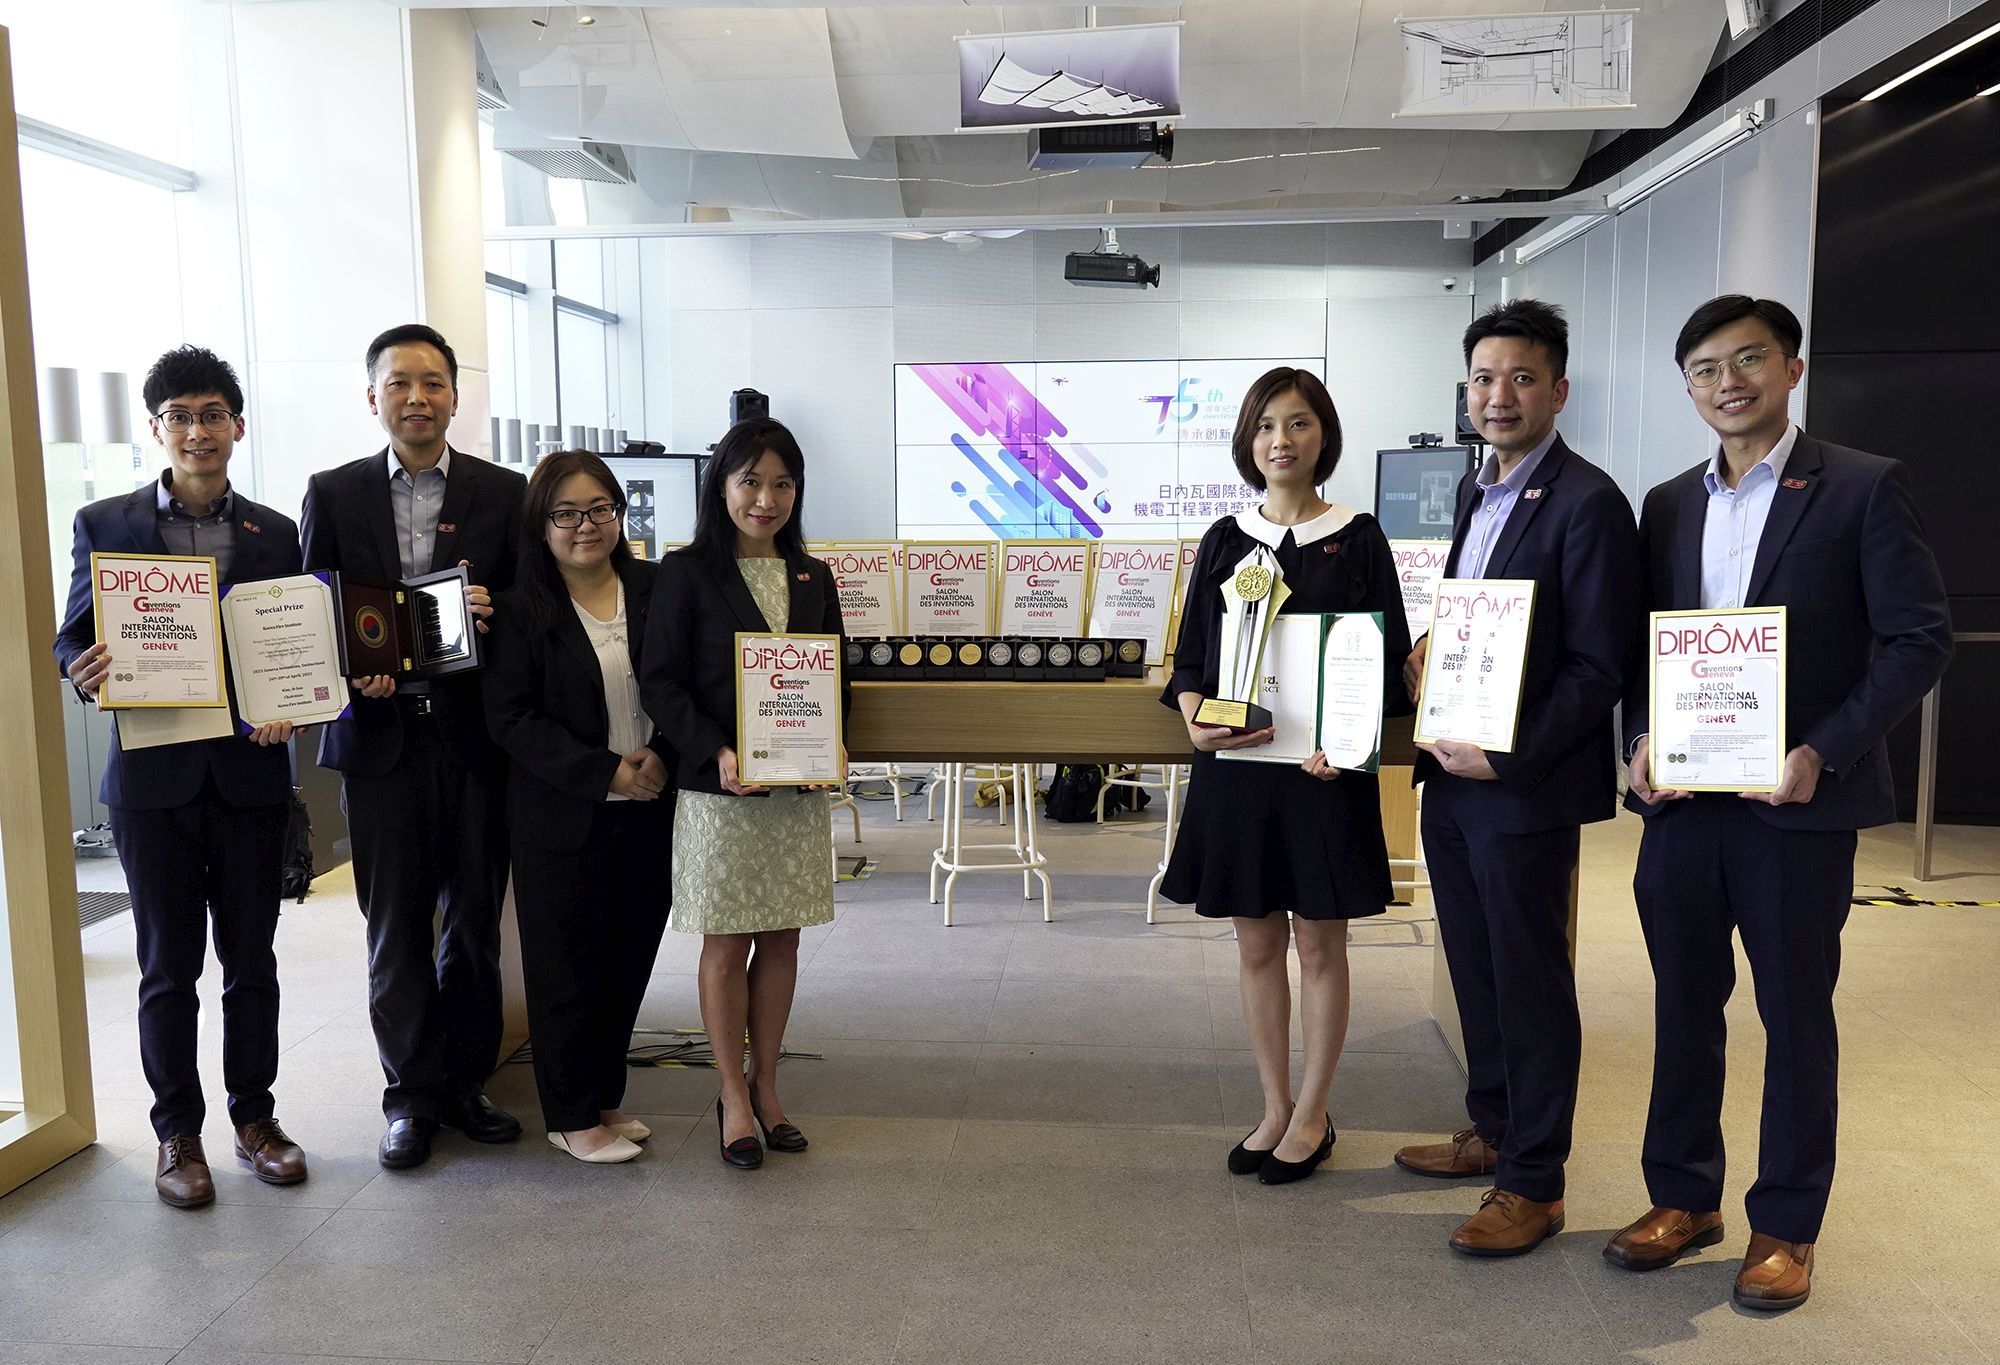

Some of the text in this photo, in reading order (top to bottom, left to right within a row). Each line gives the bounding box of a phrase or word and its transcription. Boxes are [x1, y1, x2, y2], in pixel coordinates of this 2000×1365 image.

[824, 553, 889, 573] PLÔME
[908, 549, 986, 571] DIPLÔME
[1006, 551, 1084, 572] DIPLÔME
[1100, 549, 1175, 571] DIPLÔME
[100, 567, 209, 594] DIPLÔME
[1106, 595, 1155, 603] INTERNATIONAL
[255, 603, 304, 616] Special Prize
[1117, 601, 1156, 609] INVENTIONS
[122, 624, 195, 632] INTERNATIONAL
[141, 632, 198, 640] INVENTIONS
[1658, 622, 1778, 655] DIPLÔME
[142, 641, 178, 651] GENÈVE
[743, 644, 834, 670] DIPLÔME
[1442, 662, 1456, 671] DES
[1700, 682, 1734, 692] SALON
[777, 693, 804, 701] SALON
[1677, 692, 1757, 701] INTERNATIONAL
[759, 701, 821, 709] INTERNATIONAL
[1676, 701, 1759, 711] DES INVENTIONS
[759, 709, 822, 717] DES INVENTIONS
[1697, 712, 1736, 724] GENÈVE
[776, 718, 806, 728] GENÈVE
